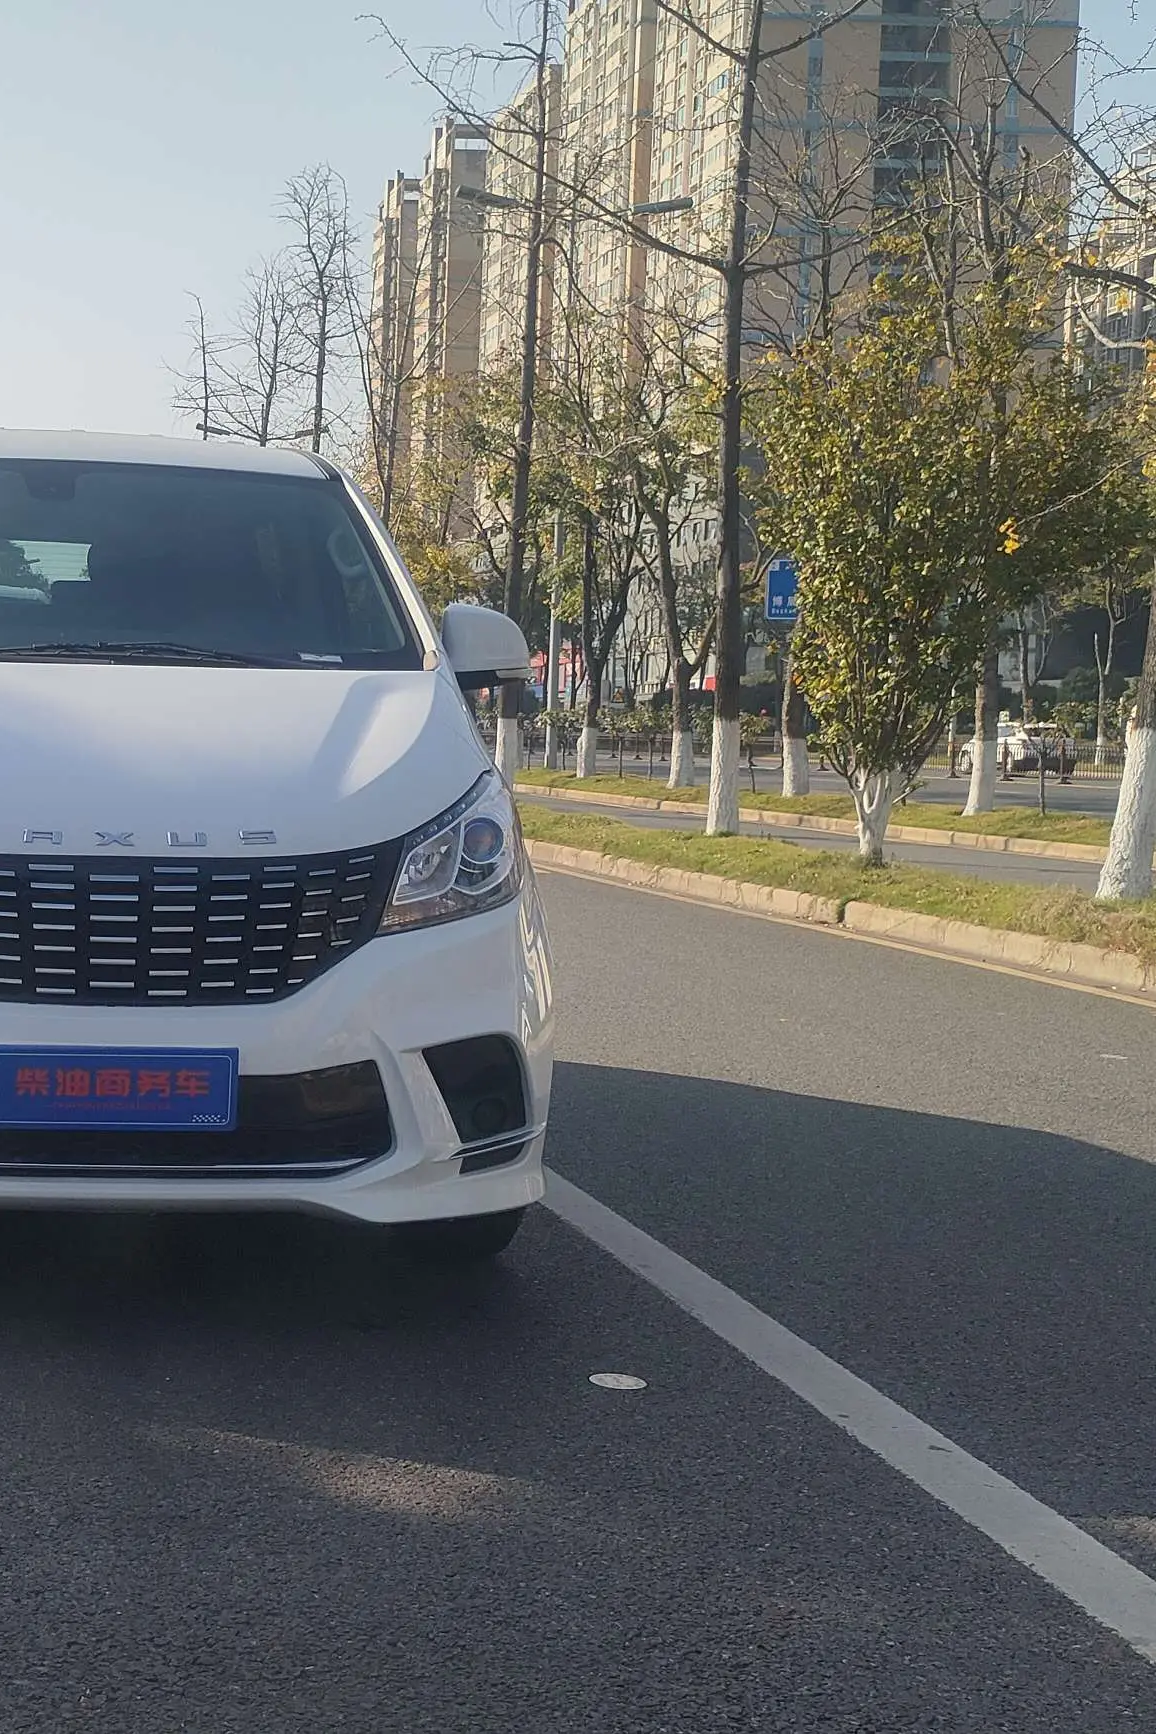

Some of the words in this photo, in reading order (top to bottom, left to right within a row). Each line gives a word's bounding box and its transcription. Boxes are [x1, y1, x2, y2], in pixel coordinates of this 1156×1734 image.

[15, 1066, 211, 1098] 柴油商务车
